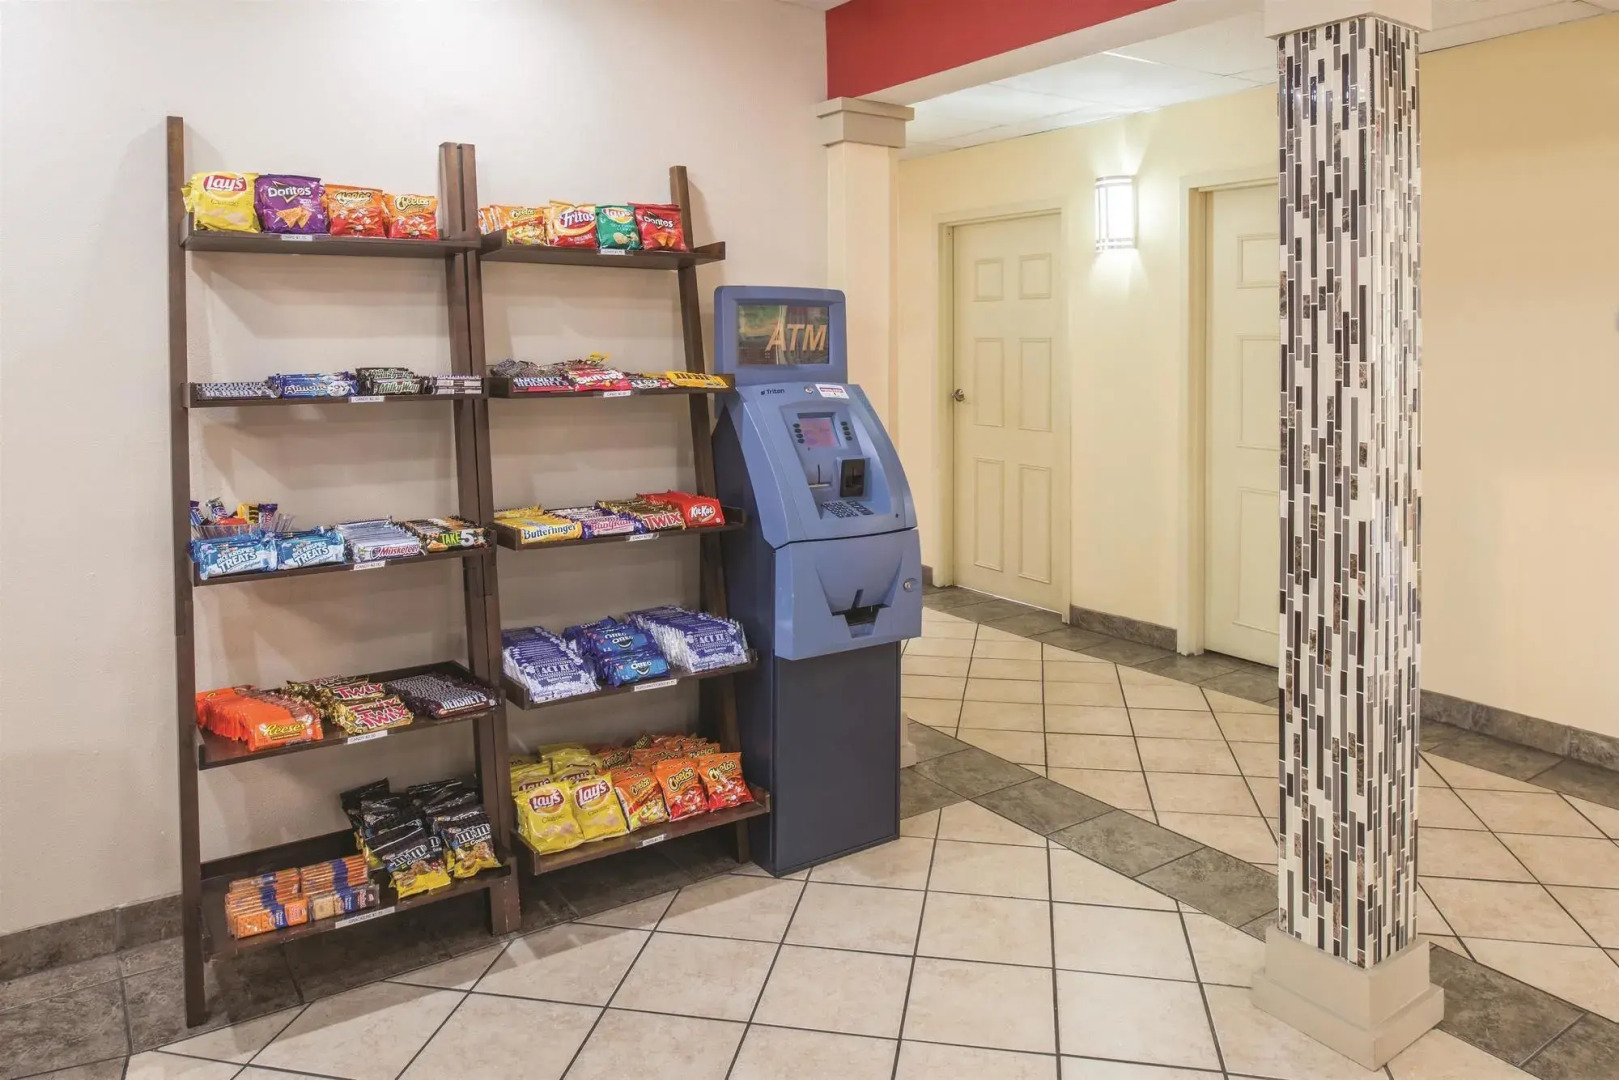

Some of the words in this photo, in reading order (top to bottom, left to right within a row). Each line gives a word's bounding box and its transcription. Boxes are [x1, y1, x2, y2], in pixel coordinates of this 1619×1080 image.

[205, 175, 244, 191] Lay's
[267, 186, 312, 198] Doritos
[560, 209, 595, 228] Fritos
[643, 214, 674, 229] Doritos
[765, 320, 828, 352] ATM
[379, 382, 401, 394] Milky
[401, 381, 420, 394] Way
[440, 532, 461, 546] TAKE
[460, 529, 475, 547] 5
[523, 522, 577, 540] Butterfinger
[217, 552, 258, 574] TREATS
[294, 545, 330, 568] TREATS
[699, 635, 715, 644] ACT
[541, 665, 558, 674] ACT
[630, 660, 652, 670] OREO
[334, 683, 383, 700] TWIX
[441, 692, 488, 710] HERSHEY'S
[357, 705, 408, 730] TWIX
[667, 766, 696, 793] Cheetos
[707, 761, 737, 782] Cheetos
[576, 781, 608, 806] Lay's
[630, 778, 652, 797] Cheetos
[532, 790, 562, 810] Lay's
